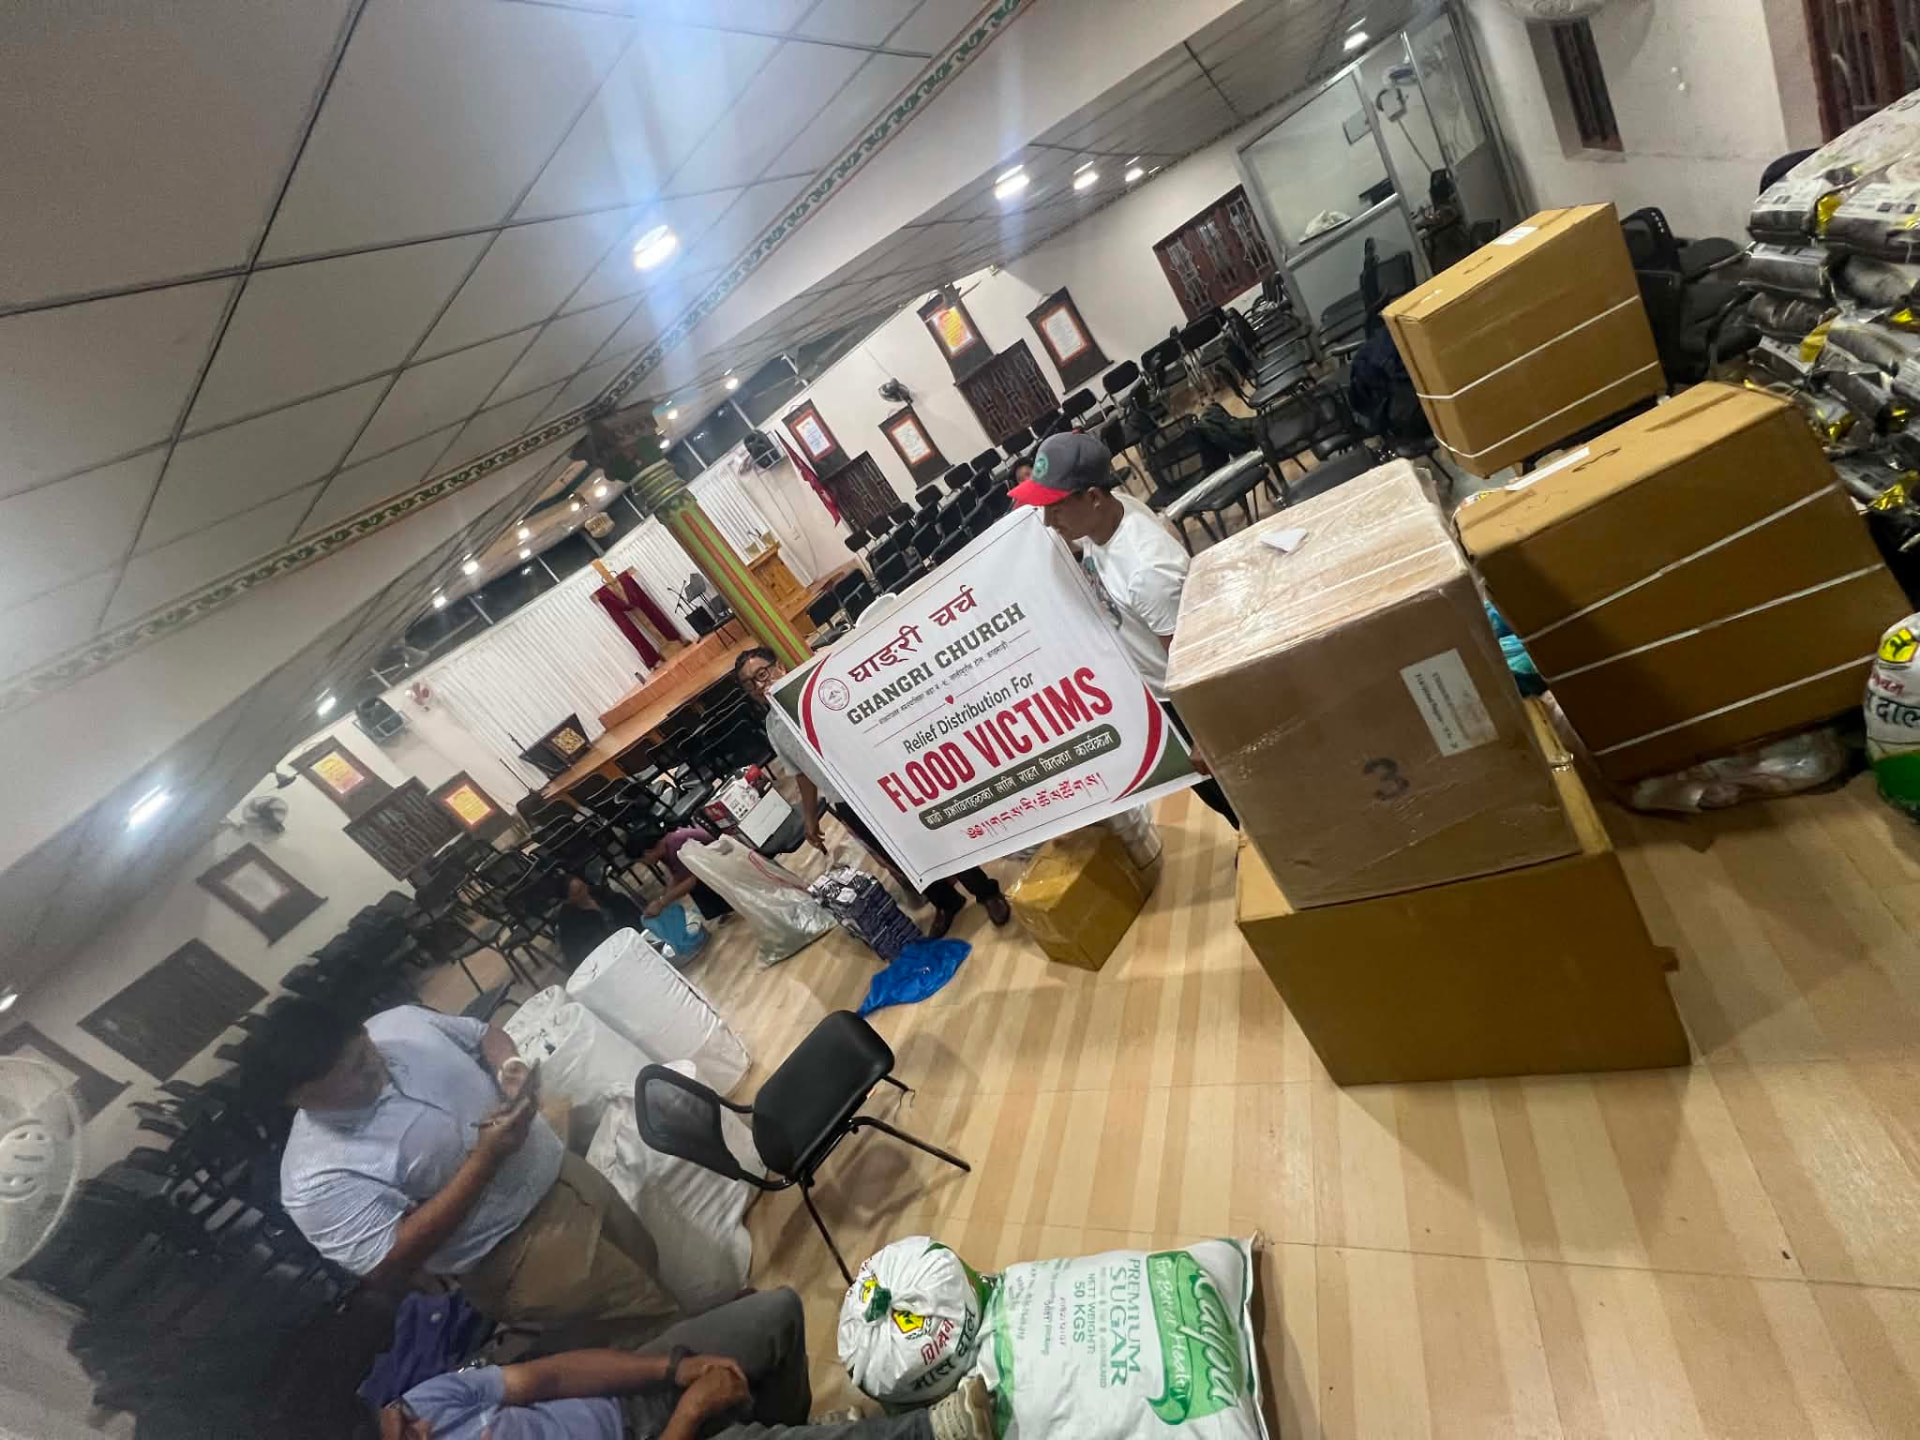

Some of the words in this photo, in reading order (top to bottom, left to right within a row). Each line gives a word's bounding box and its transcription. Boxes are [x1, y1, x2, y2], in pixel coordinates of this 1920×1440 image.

[928, 585, 977, 626] चर्च
[846, 662, 934, 725] GHANGRI
[934, 603, 1026, 669] CHURCH
[877, 742, 976, 814] FLOOD
[963, 666, 1114, 769] VICTIMS
[903, 725, 938, 754] Relief
[937, 687, 1011, 735] Distribution
[1010, 672, 1035, 694] For
[996, 775, 1015, 793] लागि
[1017, 765, 1040, 784] राहत
[1040, 750, 1073, 772] वितरण
[1073, 731, 1114, 757] कार्यक्रम
[1363, 757, 1410, 801] 3
[1074, 1281, 1086, 1299] 50
[1086, 1273, 1096, 1299] NETT
[1128, 1258, 1141, 1373] PREMIUM
[1073, 1304, 1086, 1343] KGS
[1110, 1266, 1128, 1386] SUGAR
